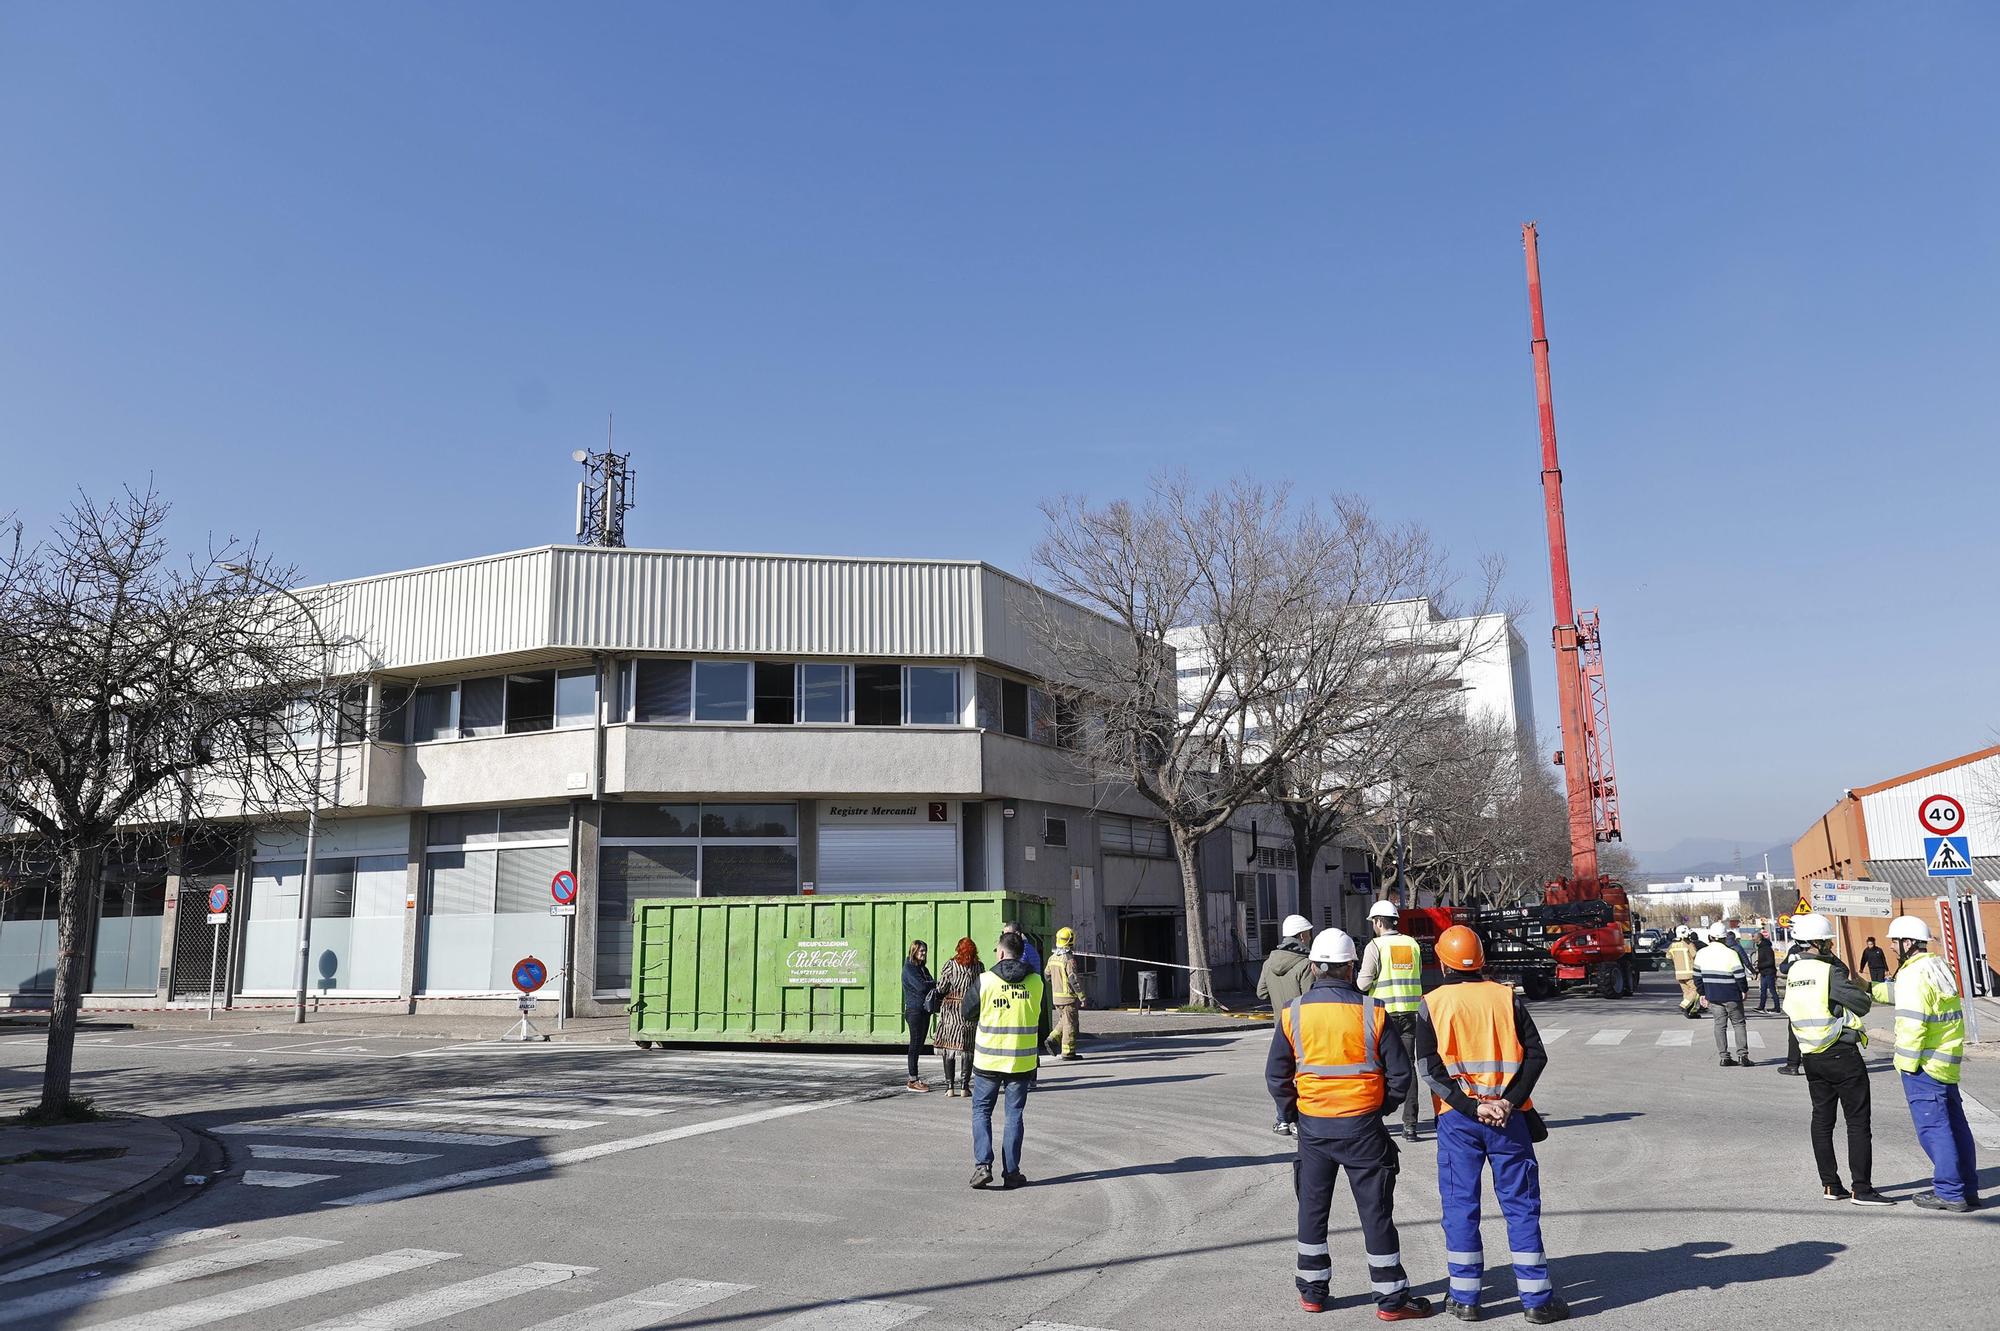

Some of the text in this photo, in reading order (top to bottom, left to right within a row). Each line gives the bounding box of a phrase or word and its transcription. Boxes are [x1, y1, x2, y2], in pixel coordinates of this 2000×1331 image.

[830, 806, 917, 817] Registre Mercantil
[1929, 808, 1955, 821] 40
[1001, 984, 1026, 992] grues
